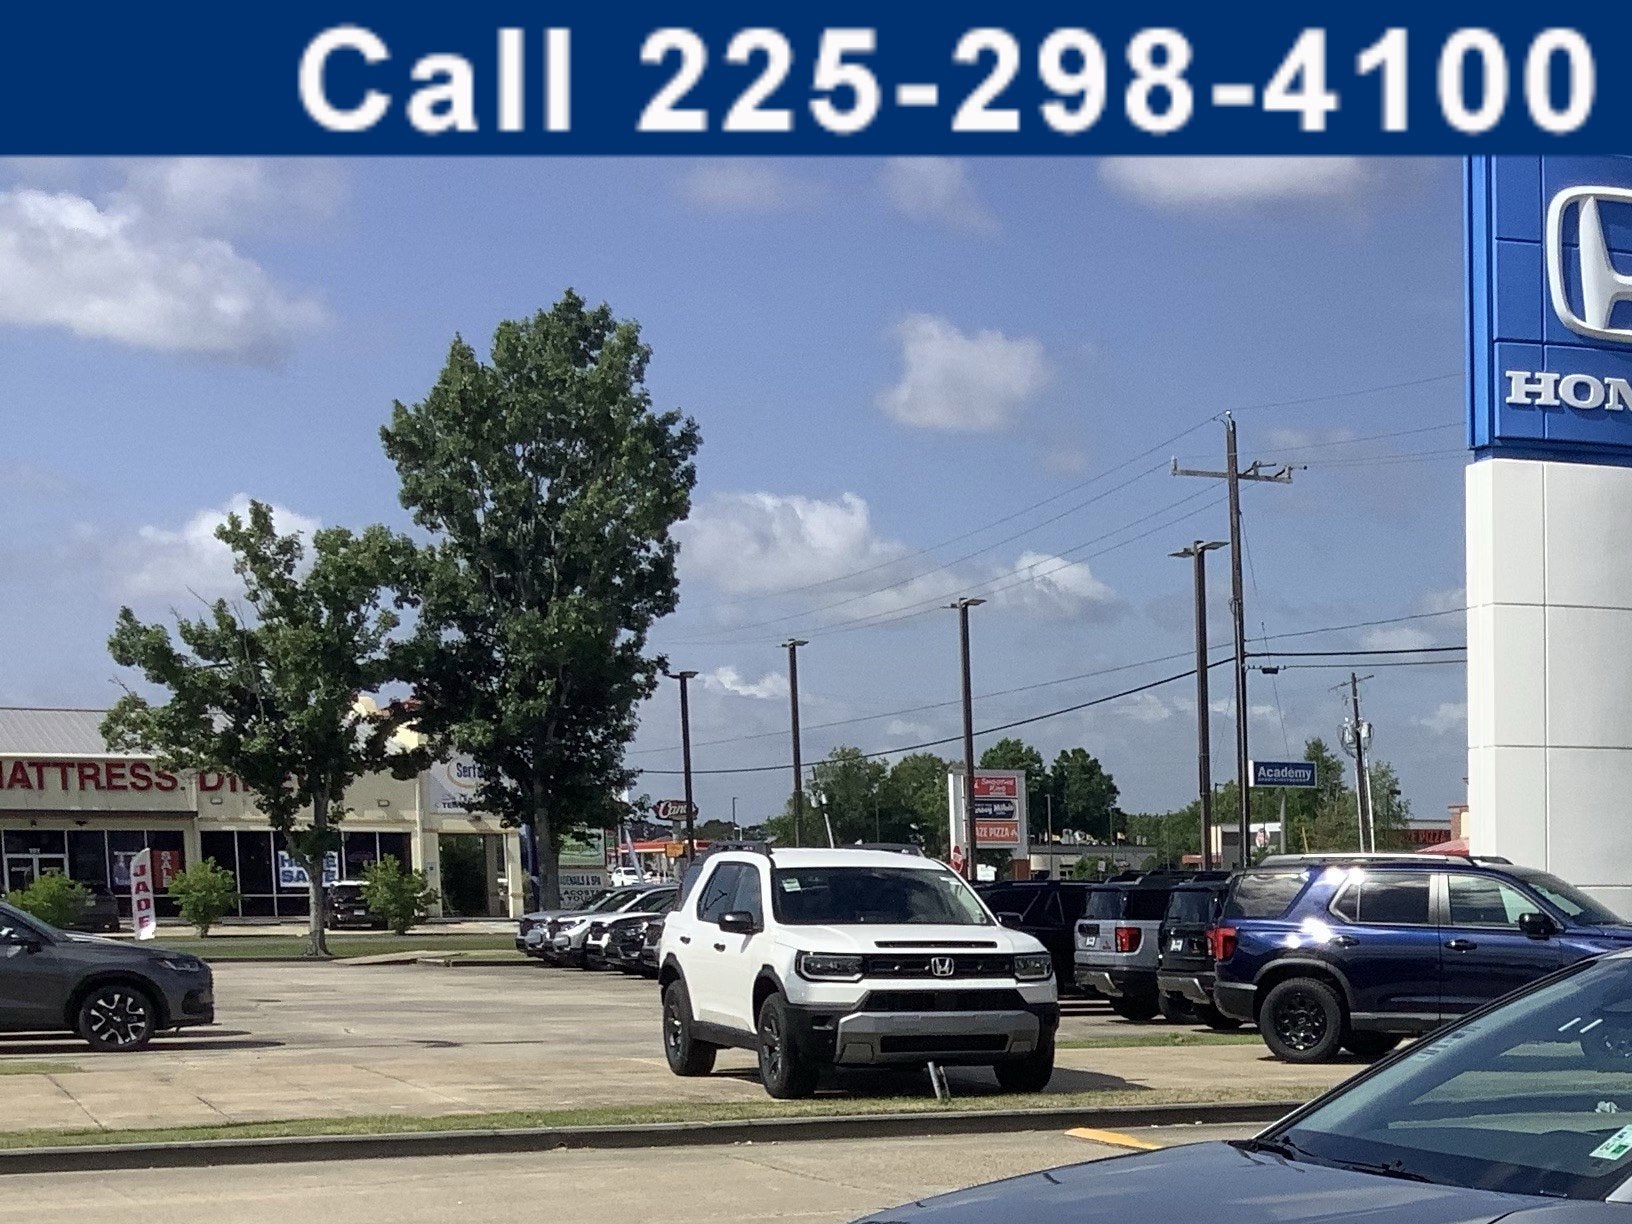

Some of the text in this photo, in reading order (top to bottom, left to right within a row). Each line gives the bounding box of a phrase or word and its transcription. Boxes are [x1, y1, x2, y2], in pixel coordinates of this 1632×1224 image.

[0, 761, 179, 792] ATTRESS
[1258, 766, 1312, 781] Academy
[989, 827, 1010, 838] PIZZA
[281, 869, 337, 883] SAE
[132, 864, 151, 928] JADE
